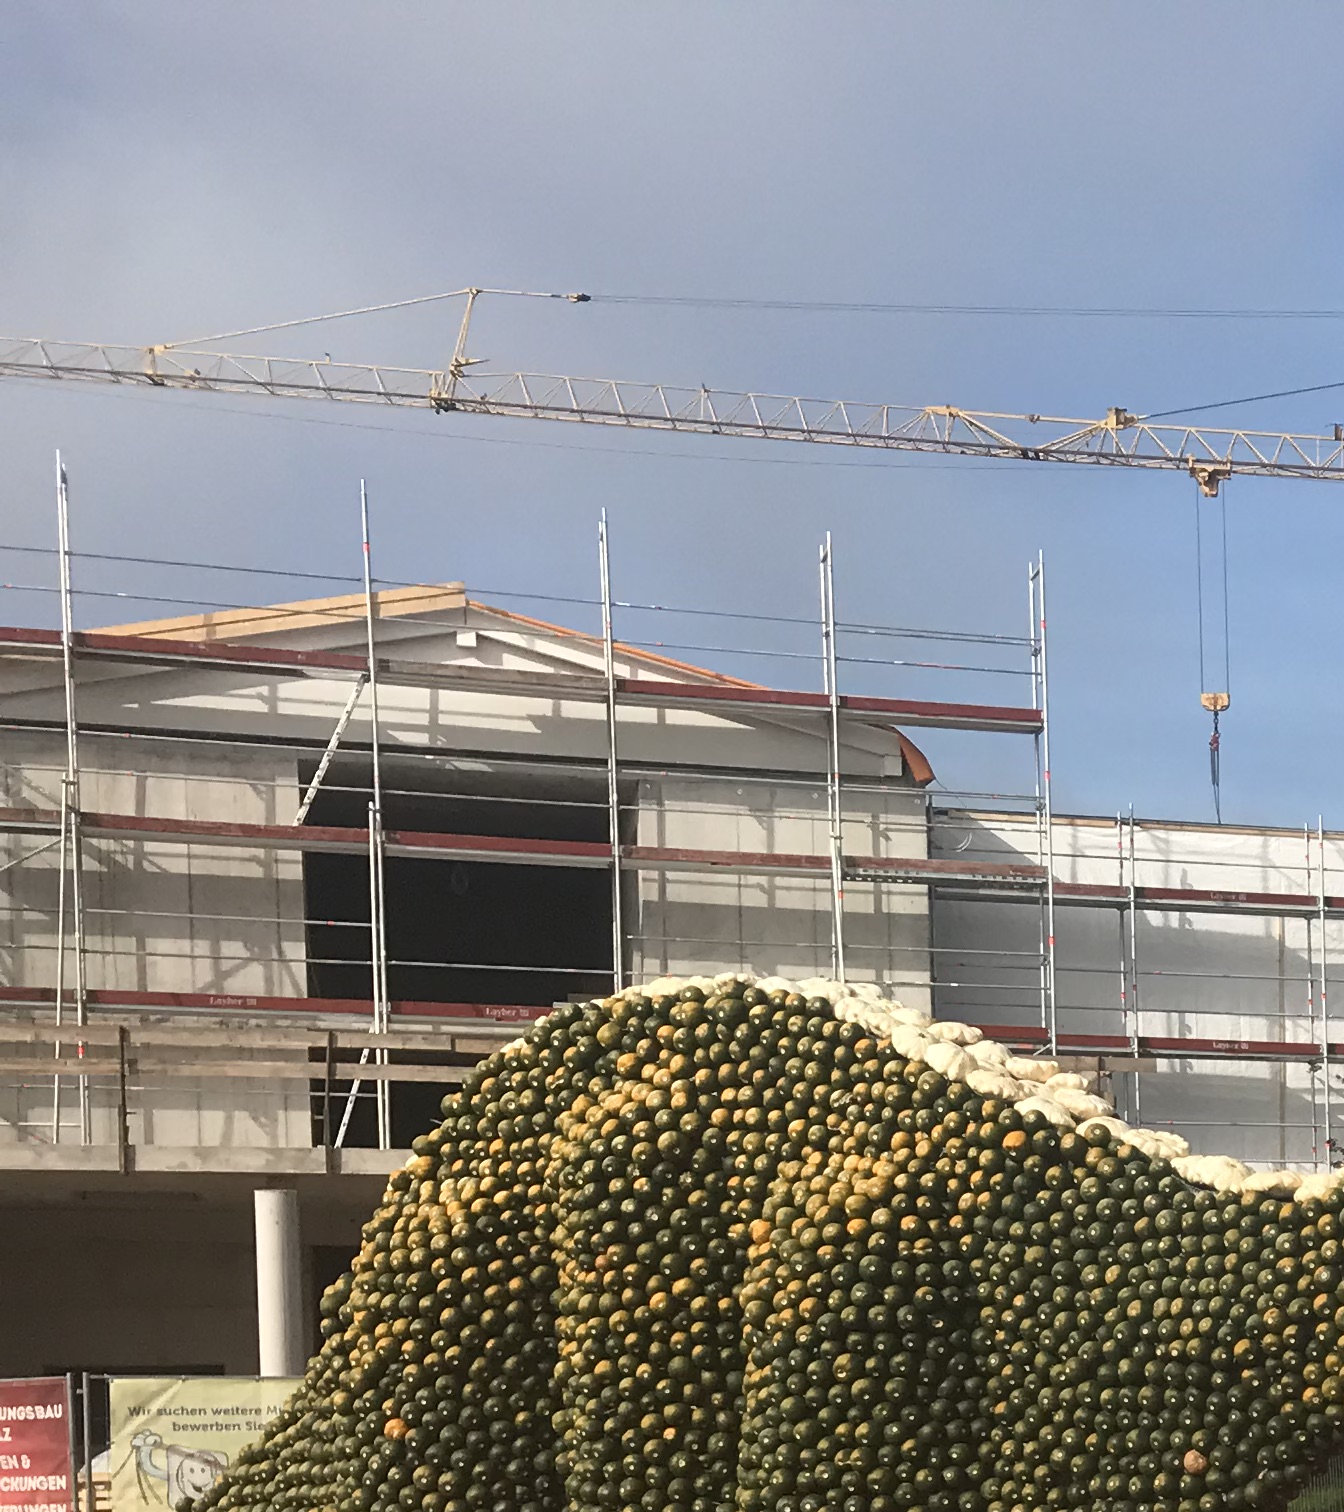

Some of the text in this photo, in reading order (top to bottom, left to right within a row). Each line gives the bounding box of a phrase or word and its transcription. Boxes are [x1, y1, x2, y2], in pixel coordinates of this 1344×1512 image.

[0, 1404, 63, 1421] UNGSBAU
[128, 1406, 151, 1416] Wir
[156, 1406, 207, 1416] suchen
[211, 1406, 262, 1416] weitere
[172, 1421, 242, 1431] bewerben
[0, 1475, 67, 1492] CKUNGEN
